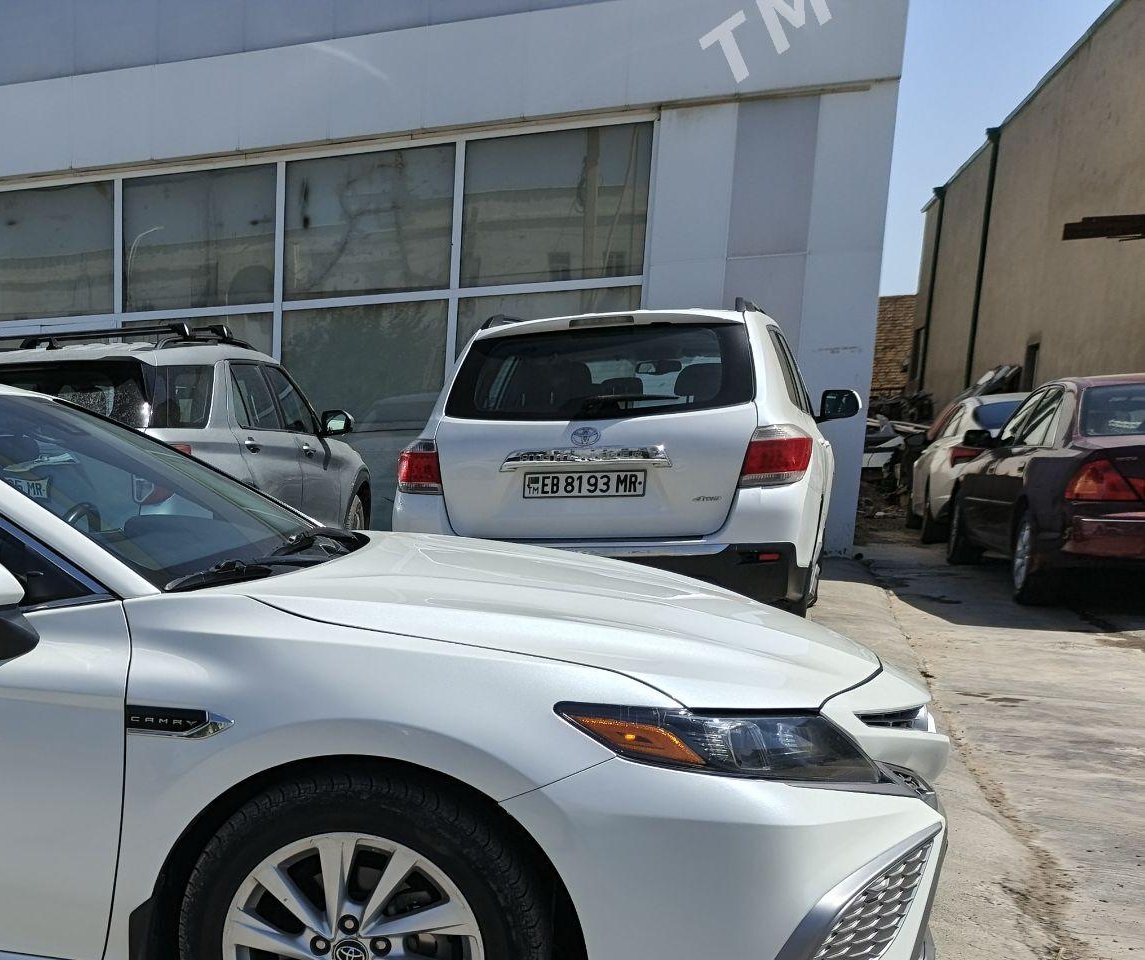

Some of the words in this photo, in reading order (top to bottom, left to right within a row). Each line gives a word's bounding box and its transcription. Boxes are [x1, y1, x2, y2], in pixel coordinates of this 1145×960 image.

[26, 481, 44, 497] MR
[541, 475, 560, 495] EB
[615, 473, 638, 493] MR
[130, 716, 198, 726] CAMRY
